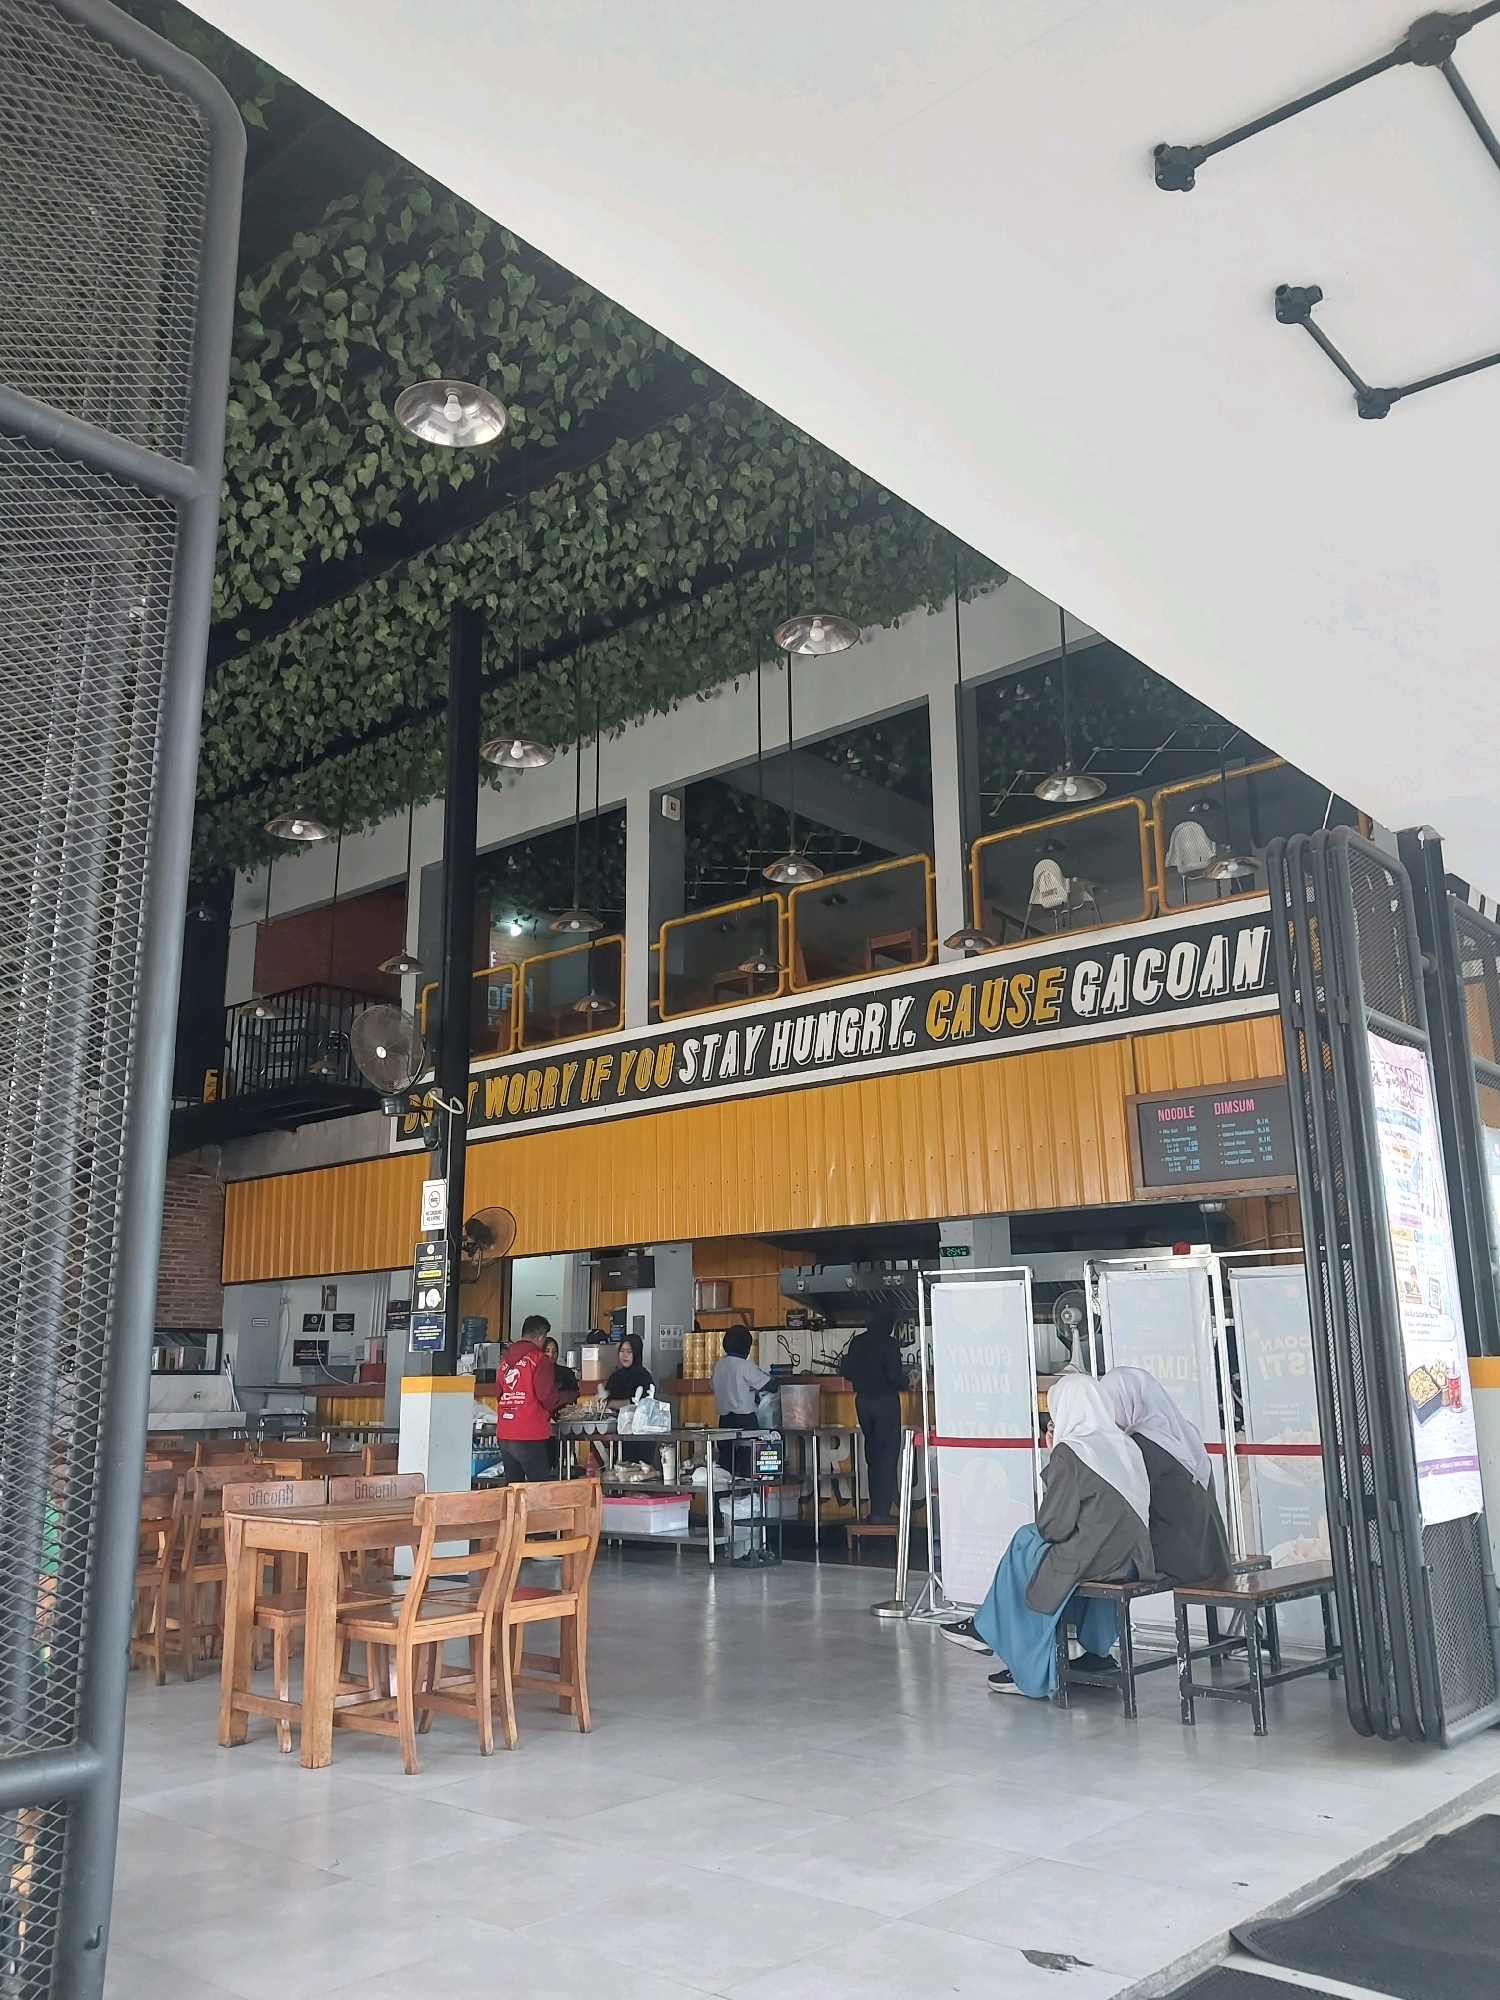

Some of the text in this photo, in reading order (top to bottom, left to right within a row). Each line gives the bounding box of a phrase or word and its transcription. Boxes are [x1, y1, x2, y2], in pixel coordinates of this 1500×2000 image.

[403, 925, 1271, 1134] DOT WORRY IF YOU STAY HUNGRY. CAUSE GACOAN
[1157, 1098, 1255, 1122] NOODLE DIMSUM
[248, 1484, 294, 1506] GACOAN
[354, 1478, 398, 1500] GACOAN
